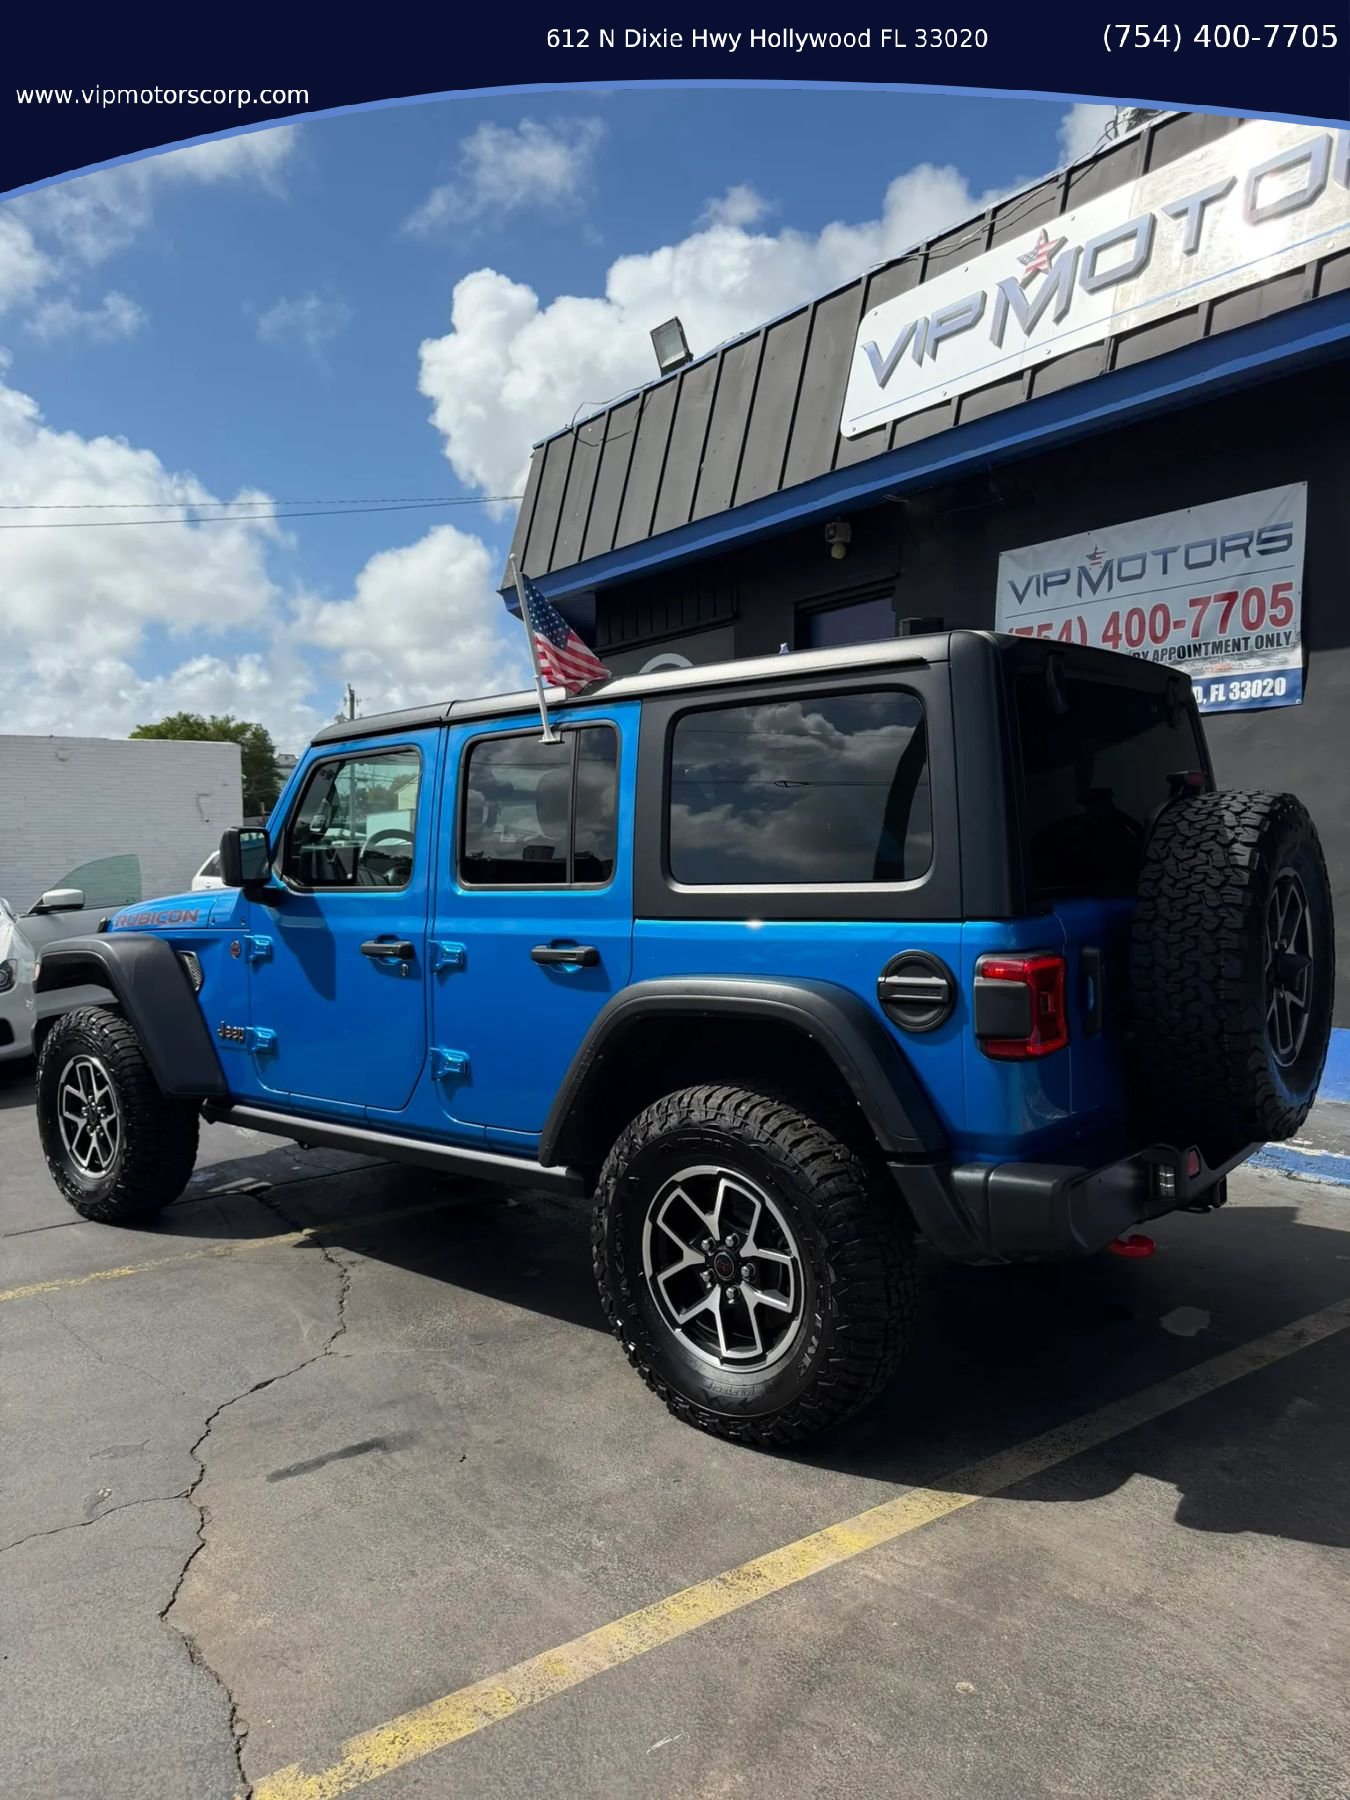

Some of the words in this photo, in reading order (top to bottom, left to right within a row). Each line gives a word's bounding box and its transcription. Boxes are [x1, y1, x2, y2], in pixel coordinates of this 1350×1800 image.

[1101, 582, 1294, 650] 400-7705
[1152, 636, 1250, 663] APPOINTMENT
[1254, 630, 1292, 650] ONLY
[1210, 683, 1226, 702] FL
[1228, 677, 1287, 700] 33020
[114, 909, 200, 928] RUBICON
